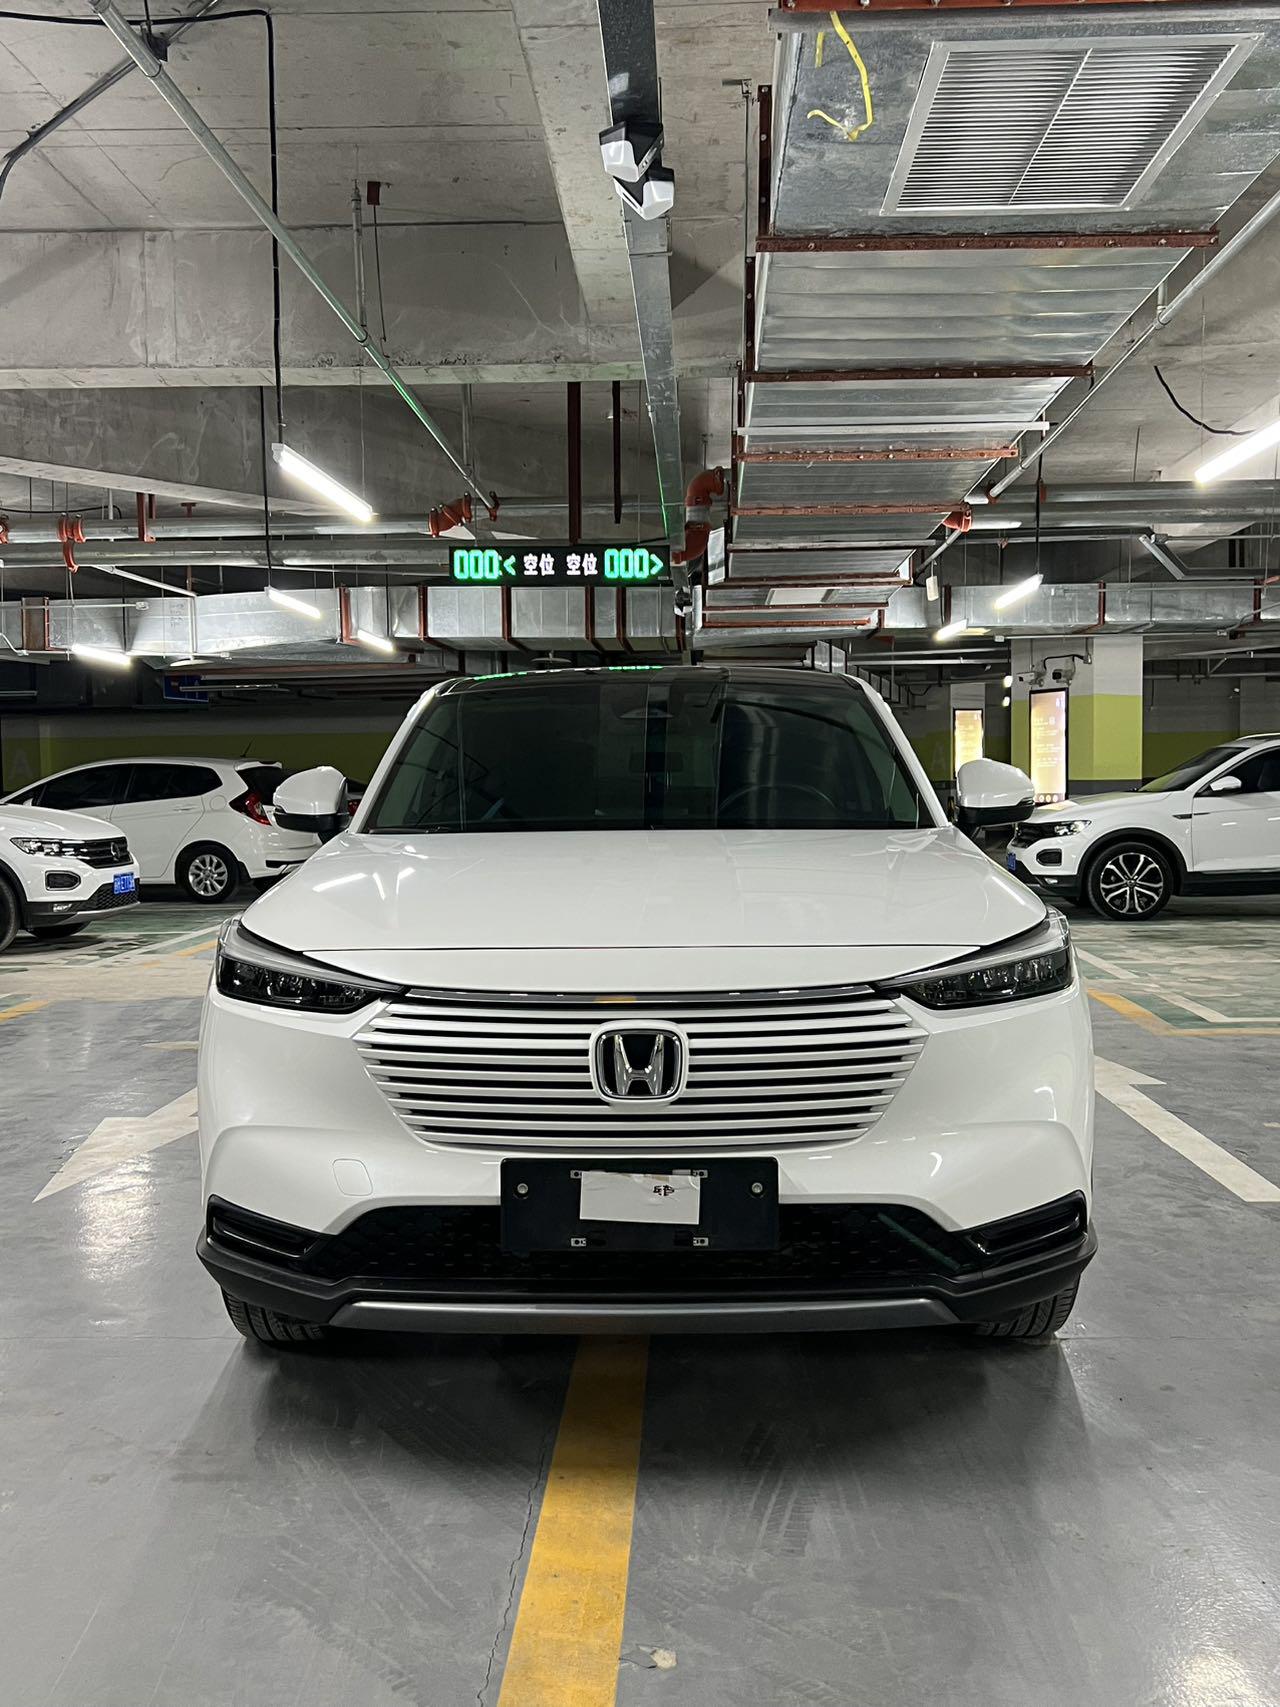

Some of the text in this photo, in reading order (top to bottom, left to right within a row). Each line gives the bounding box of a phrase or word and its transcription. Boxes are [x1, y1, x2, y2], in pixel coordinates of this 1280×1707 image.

[453, 548, 650, 580] 000 空位 空位 000
